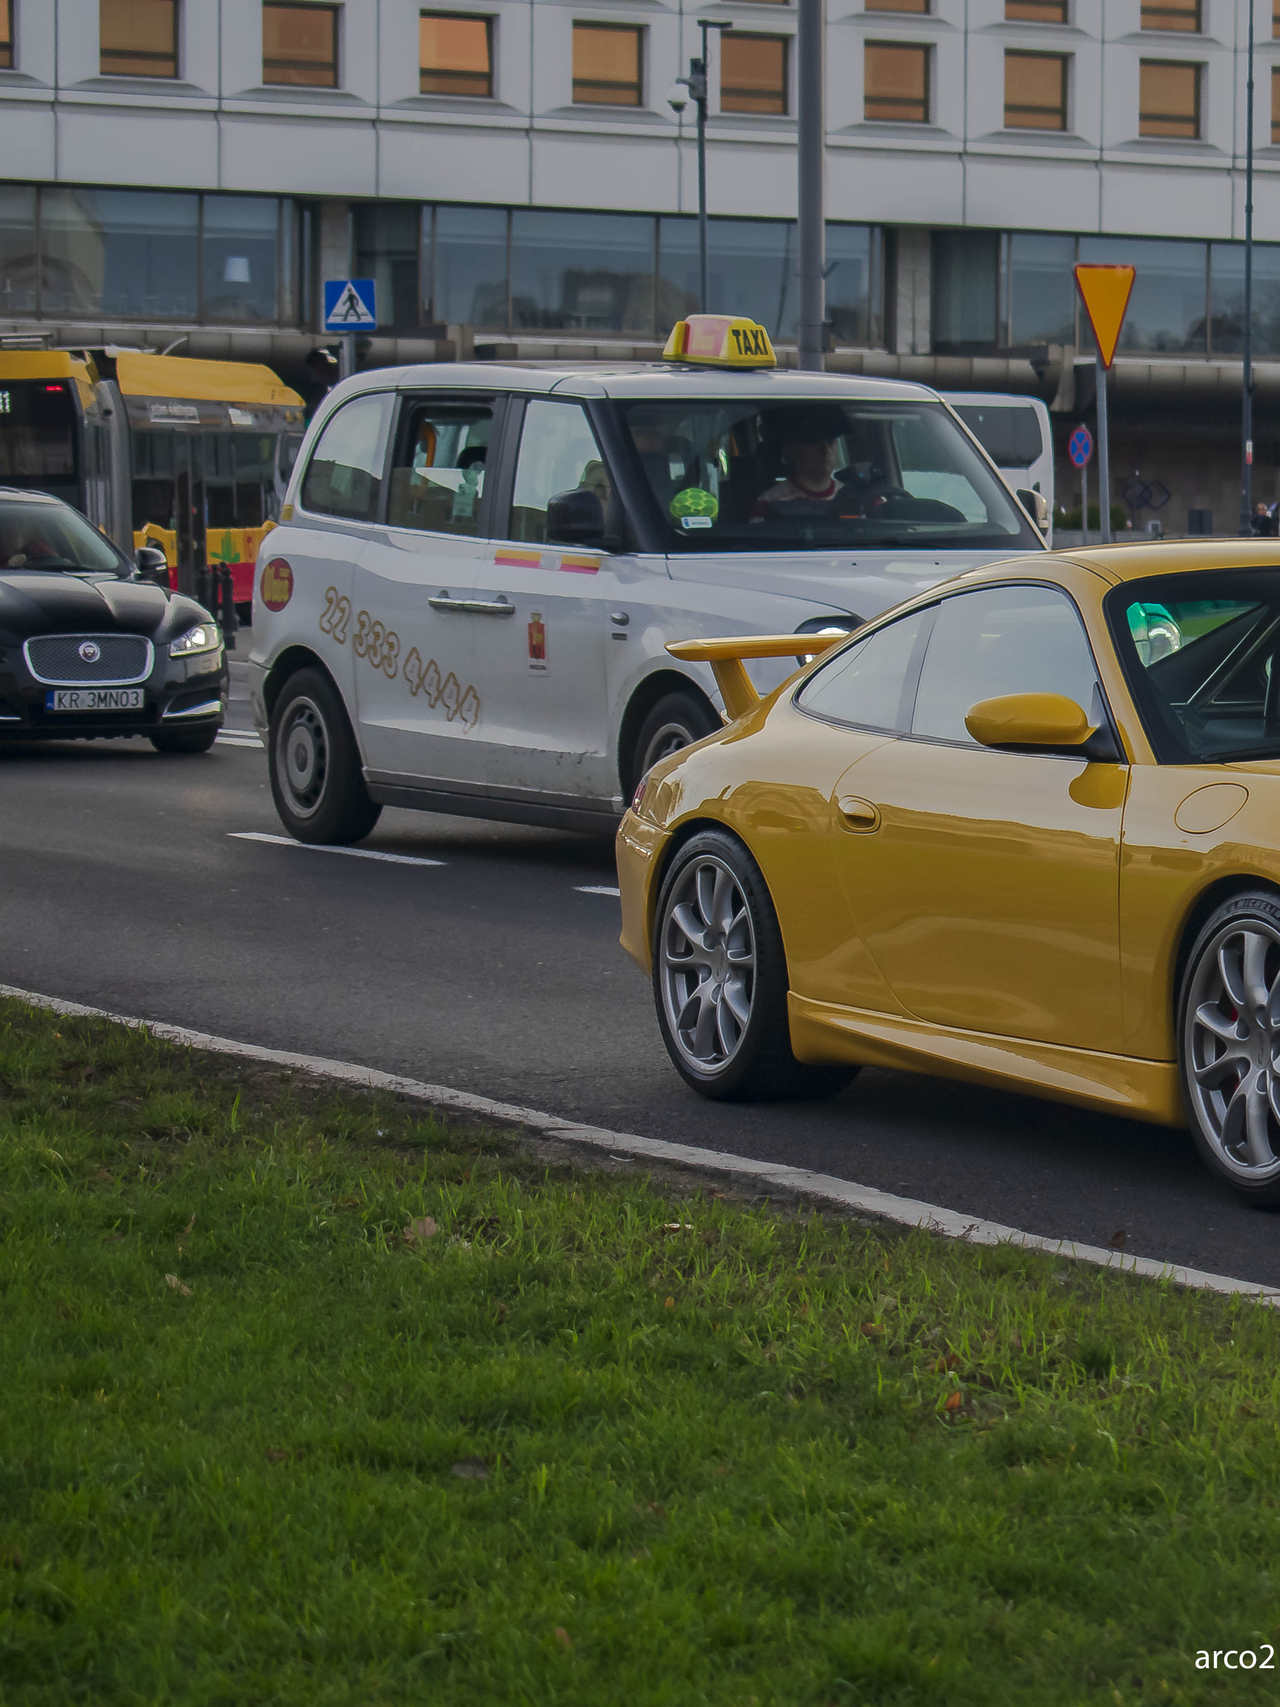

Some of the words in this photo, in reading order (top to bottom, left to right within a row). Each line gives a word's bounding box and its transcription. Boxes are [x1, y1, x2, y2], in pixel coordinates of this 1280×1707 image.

[731, 329, 768, 356] TAXI
[319, 586, 351, 645] 22
[353, 610, 400, 680] 333
[403, 646, 480, 735] 4444
[57, 692, 80, 709] KR
